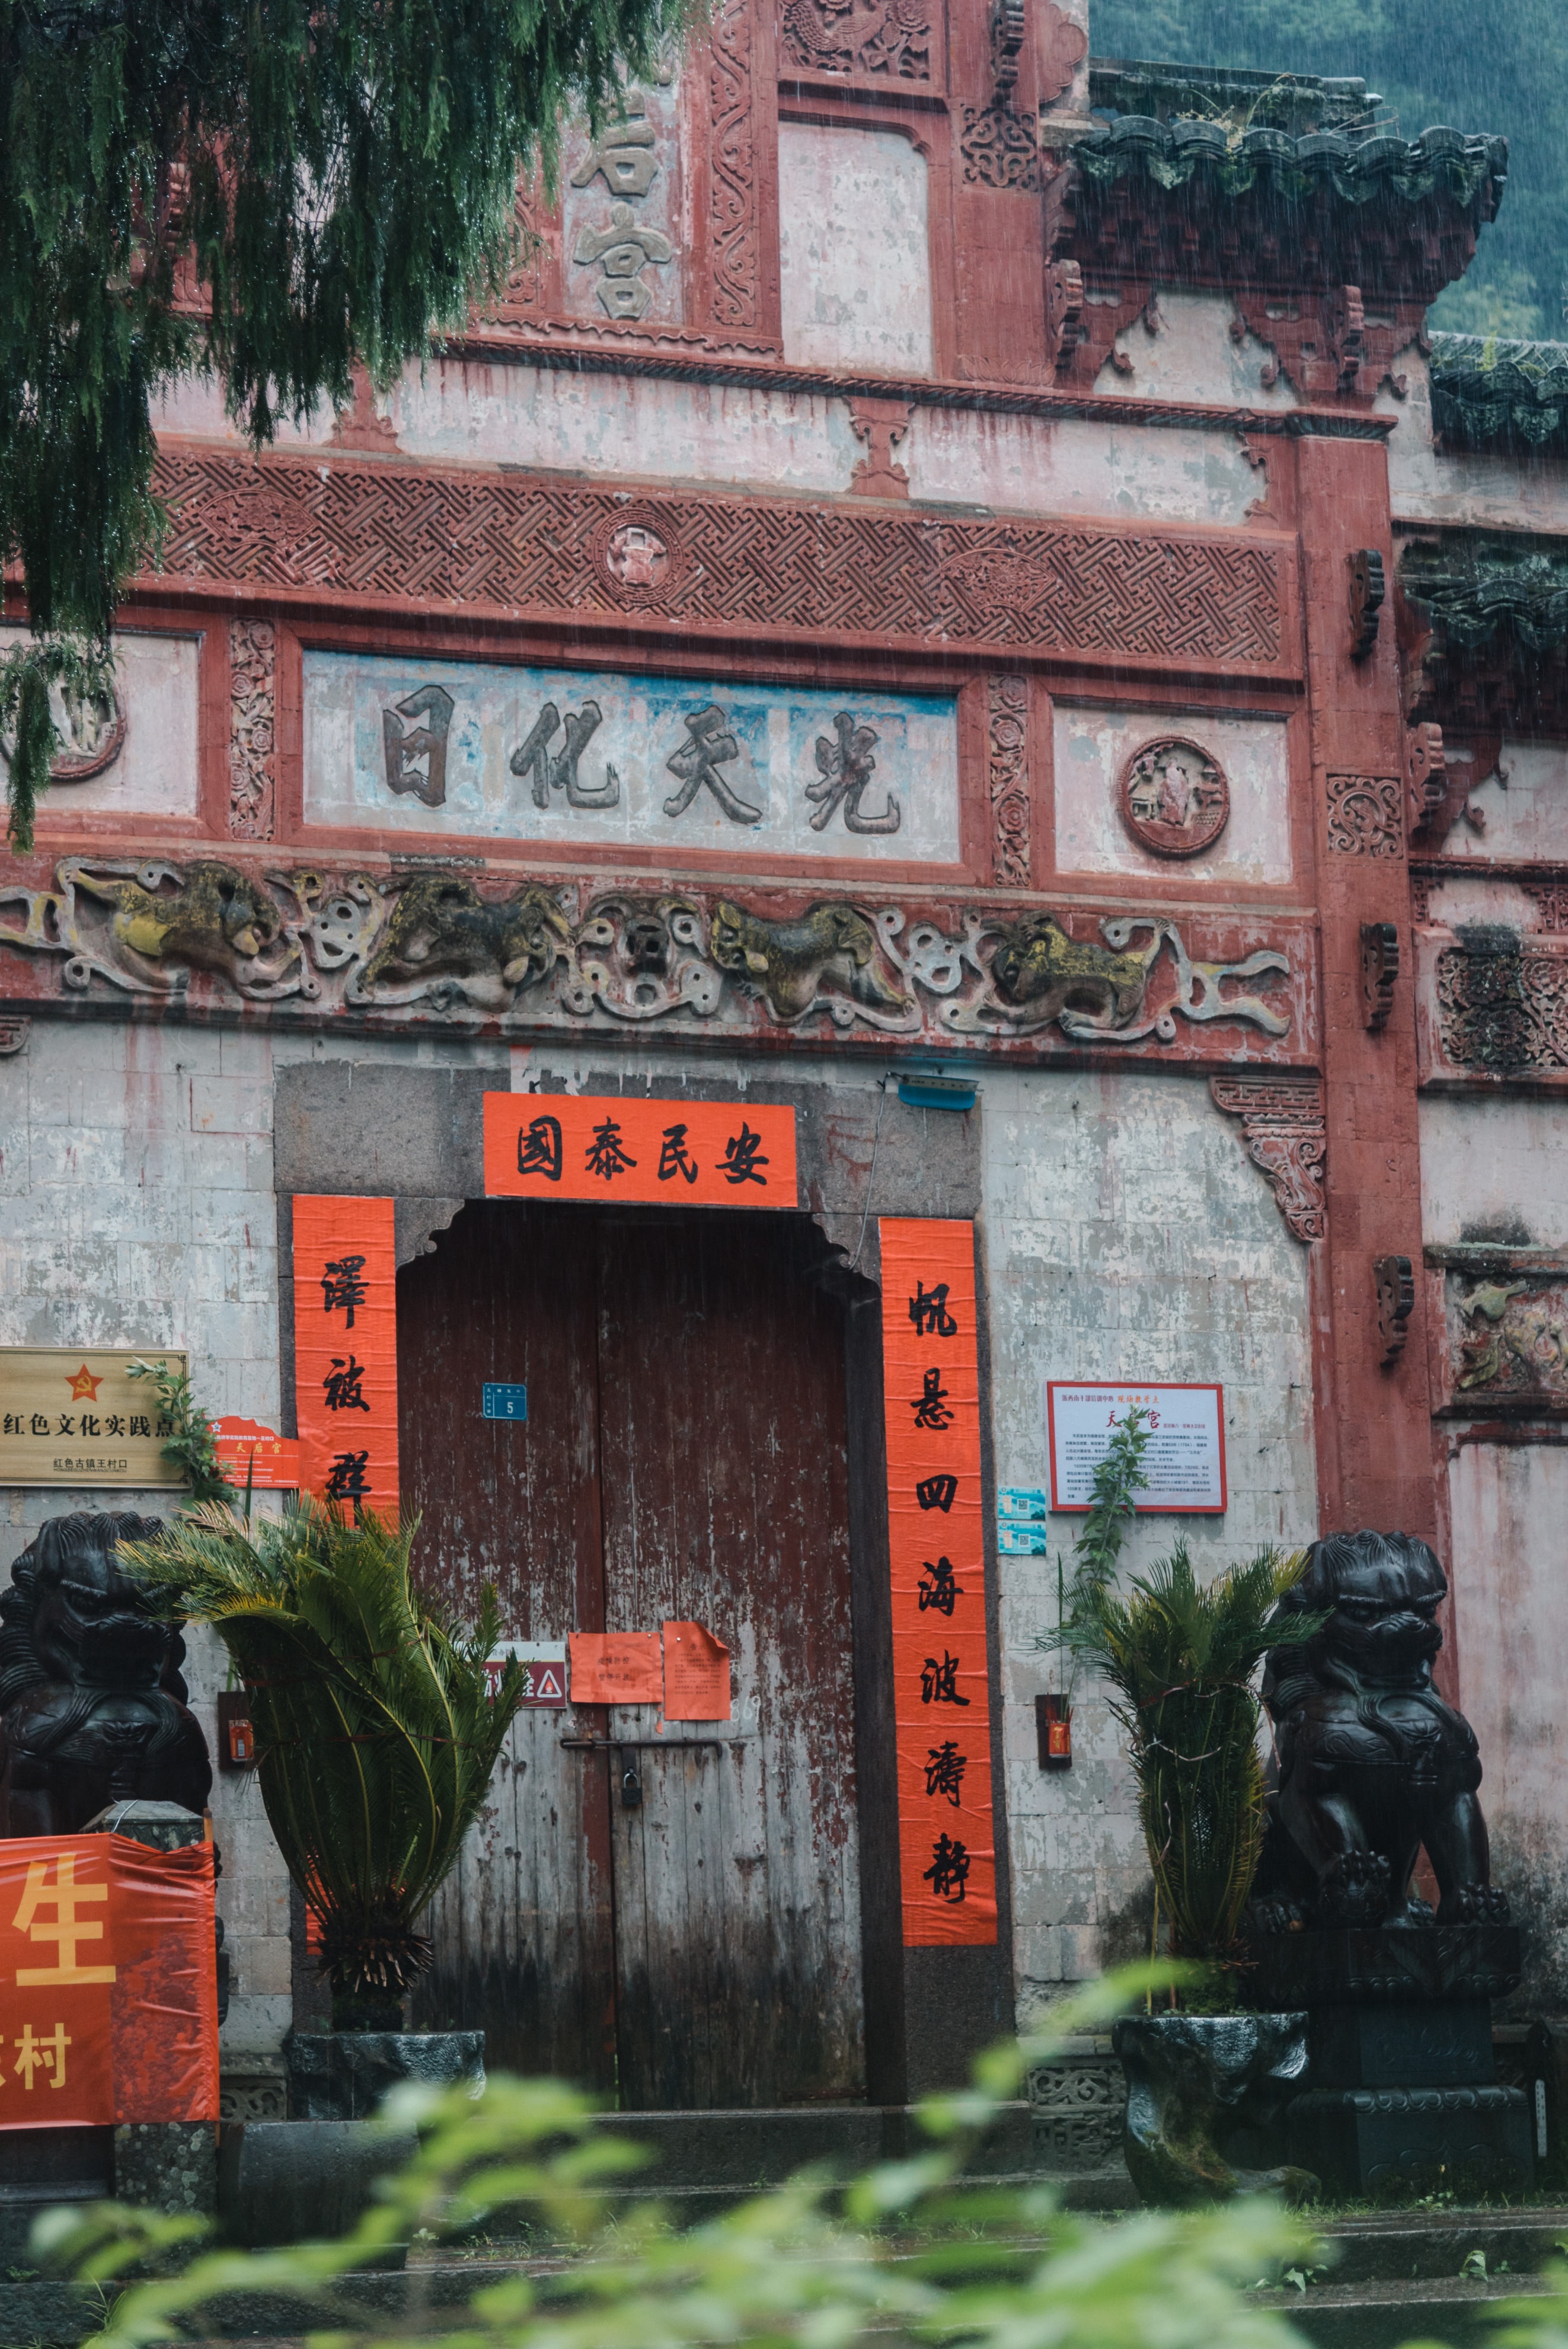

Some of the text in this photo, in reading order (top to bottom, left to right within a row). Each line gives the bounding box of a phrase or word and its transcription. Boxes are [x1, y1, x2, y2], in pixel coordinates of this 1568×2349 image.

[507, 1402, 513, 1413] 5
[3, 1413, 175, 1437] 红色文化实践点
[236, 1442, 282, 1454] 天后宫
[53, 1458, 127, 1469] 红色古镇王村口
[598, 1656, 630, 1665] 疫情防控
[598, 1673, 630, 1682] 暂停开放
[12, 1853, 116, 1986] 生
[0, 2022, 72, 2090] 村
